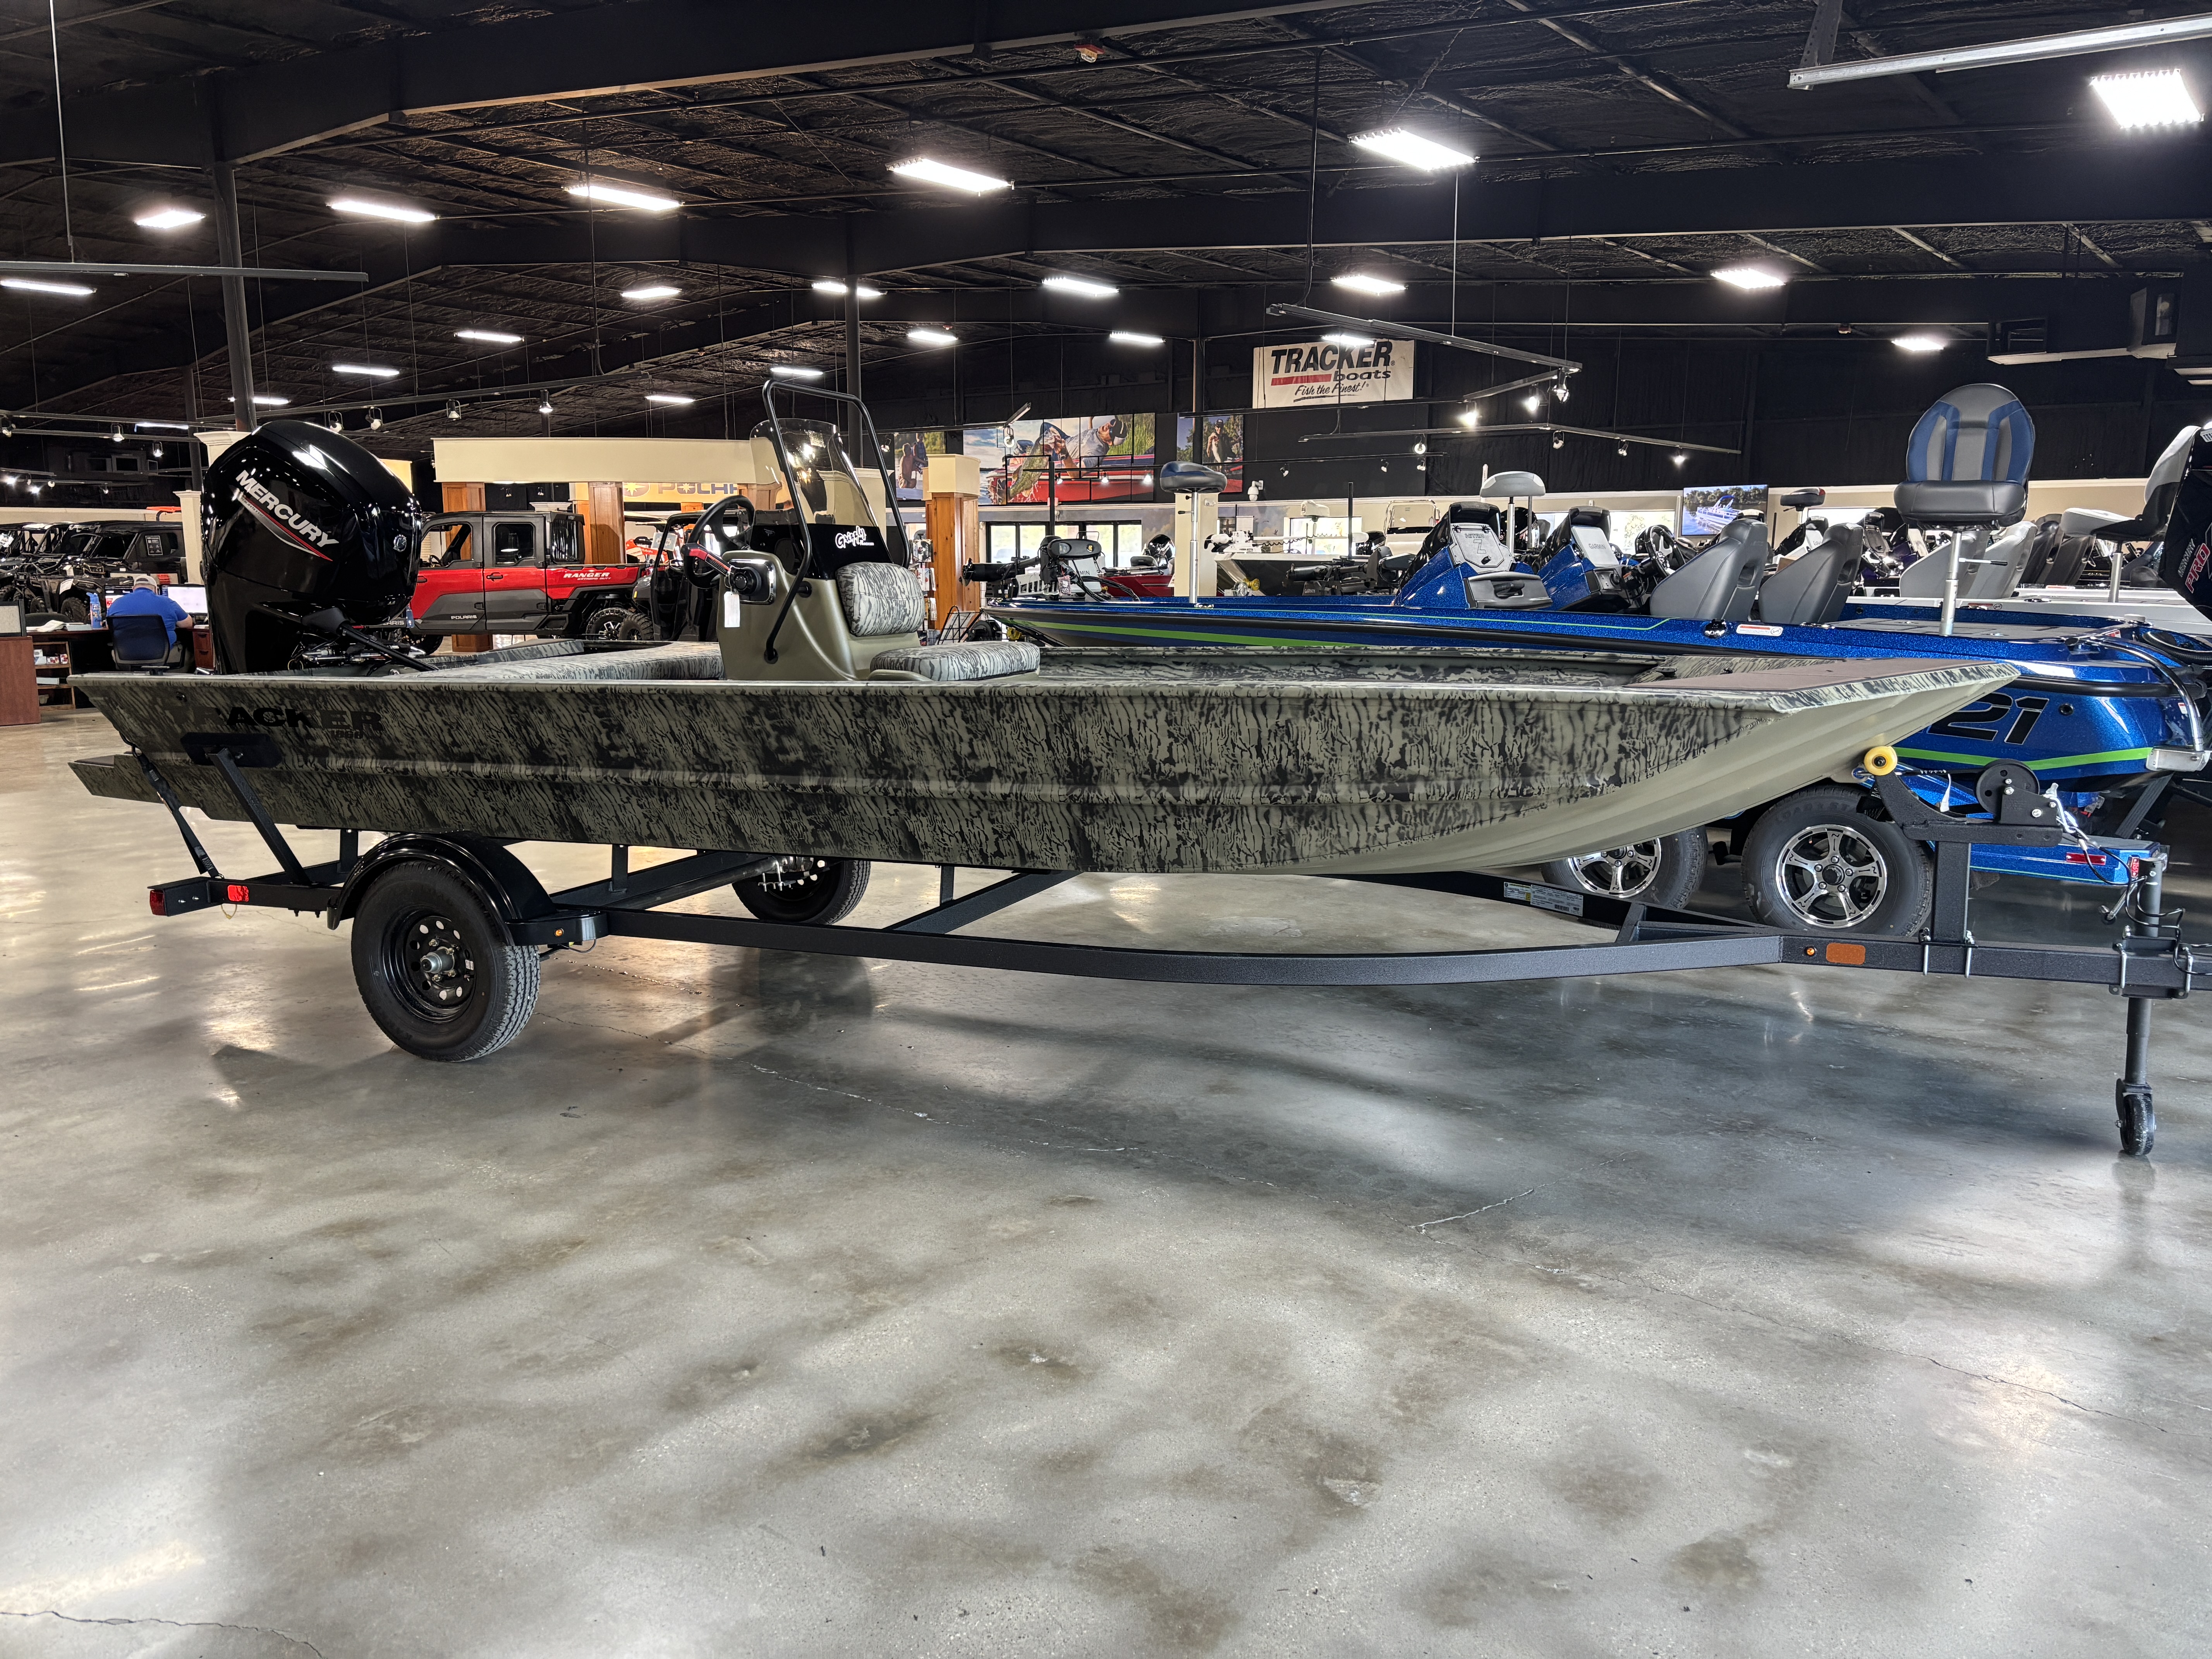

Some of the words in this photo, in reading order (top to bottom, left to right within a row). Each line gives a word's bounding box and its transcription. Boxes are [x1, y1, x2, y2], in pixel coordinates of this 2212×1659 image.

[1271, 341, 1393, 374] TRACKER
[1333, 370, 1391, 382] boats
[1295, 385, 1315, 396] Fish
[1317, 385, 1330, 394] the
[1332, 381, 1366, 393] Finest!
[235, 470, 339, 547] MERCURY
[2178, 538, 2195, 577] MERCURY
[2185, 543, 2210, 594] PRO
[1926, 692, 2050, 745] 21
